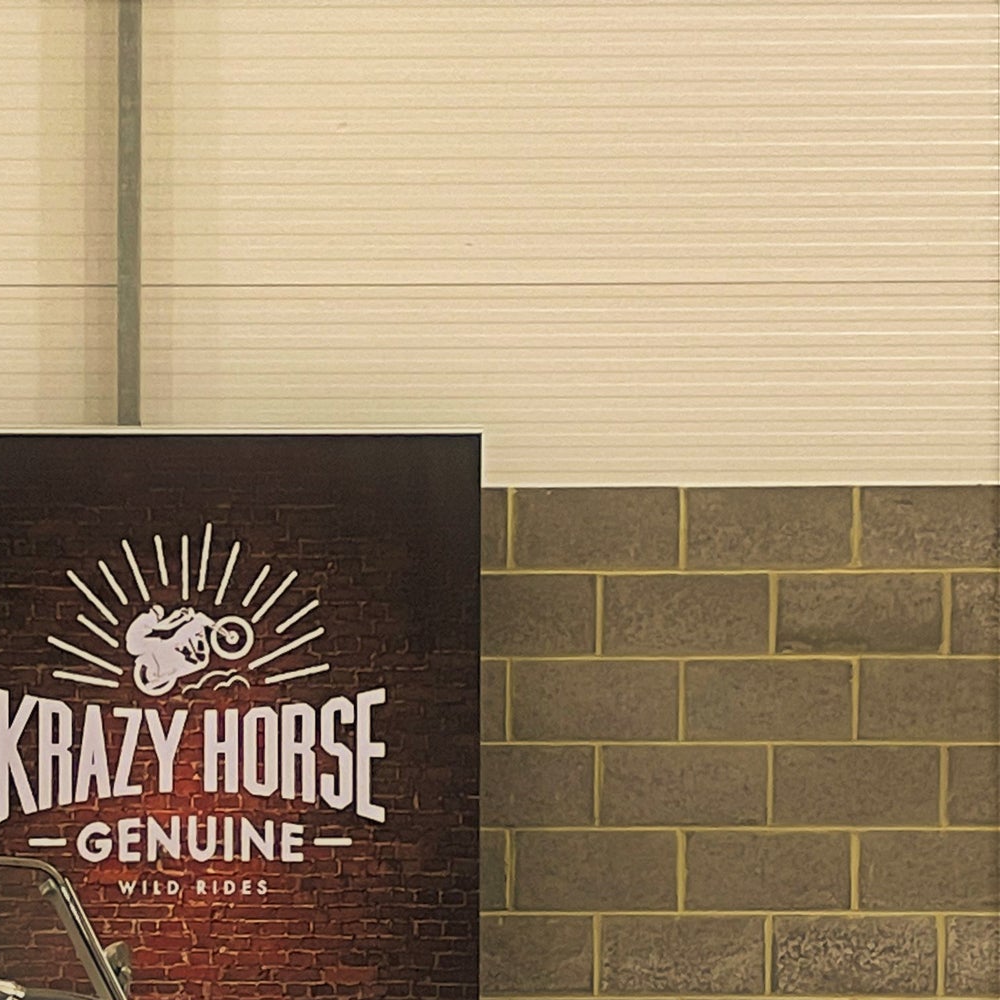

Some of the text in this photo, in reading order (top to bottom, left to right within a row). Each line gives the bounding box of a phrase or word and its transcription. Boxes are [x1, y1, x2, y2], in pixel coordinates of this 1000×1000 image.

[203, 688, 386, 823] HORSE
[76, 816, 305, 863] GENUINE
[118, 879, 269, 896] WILD RIDES
